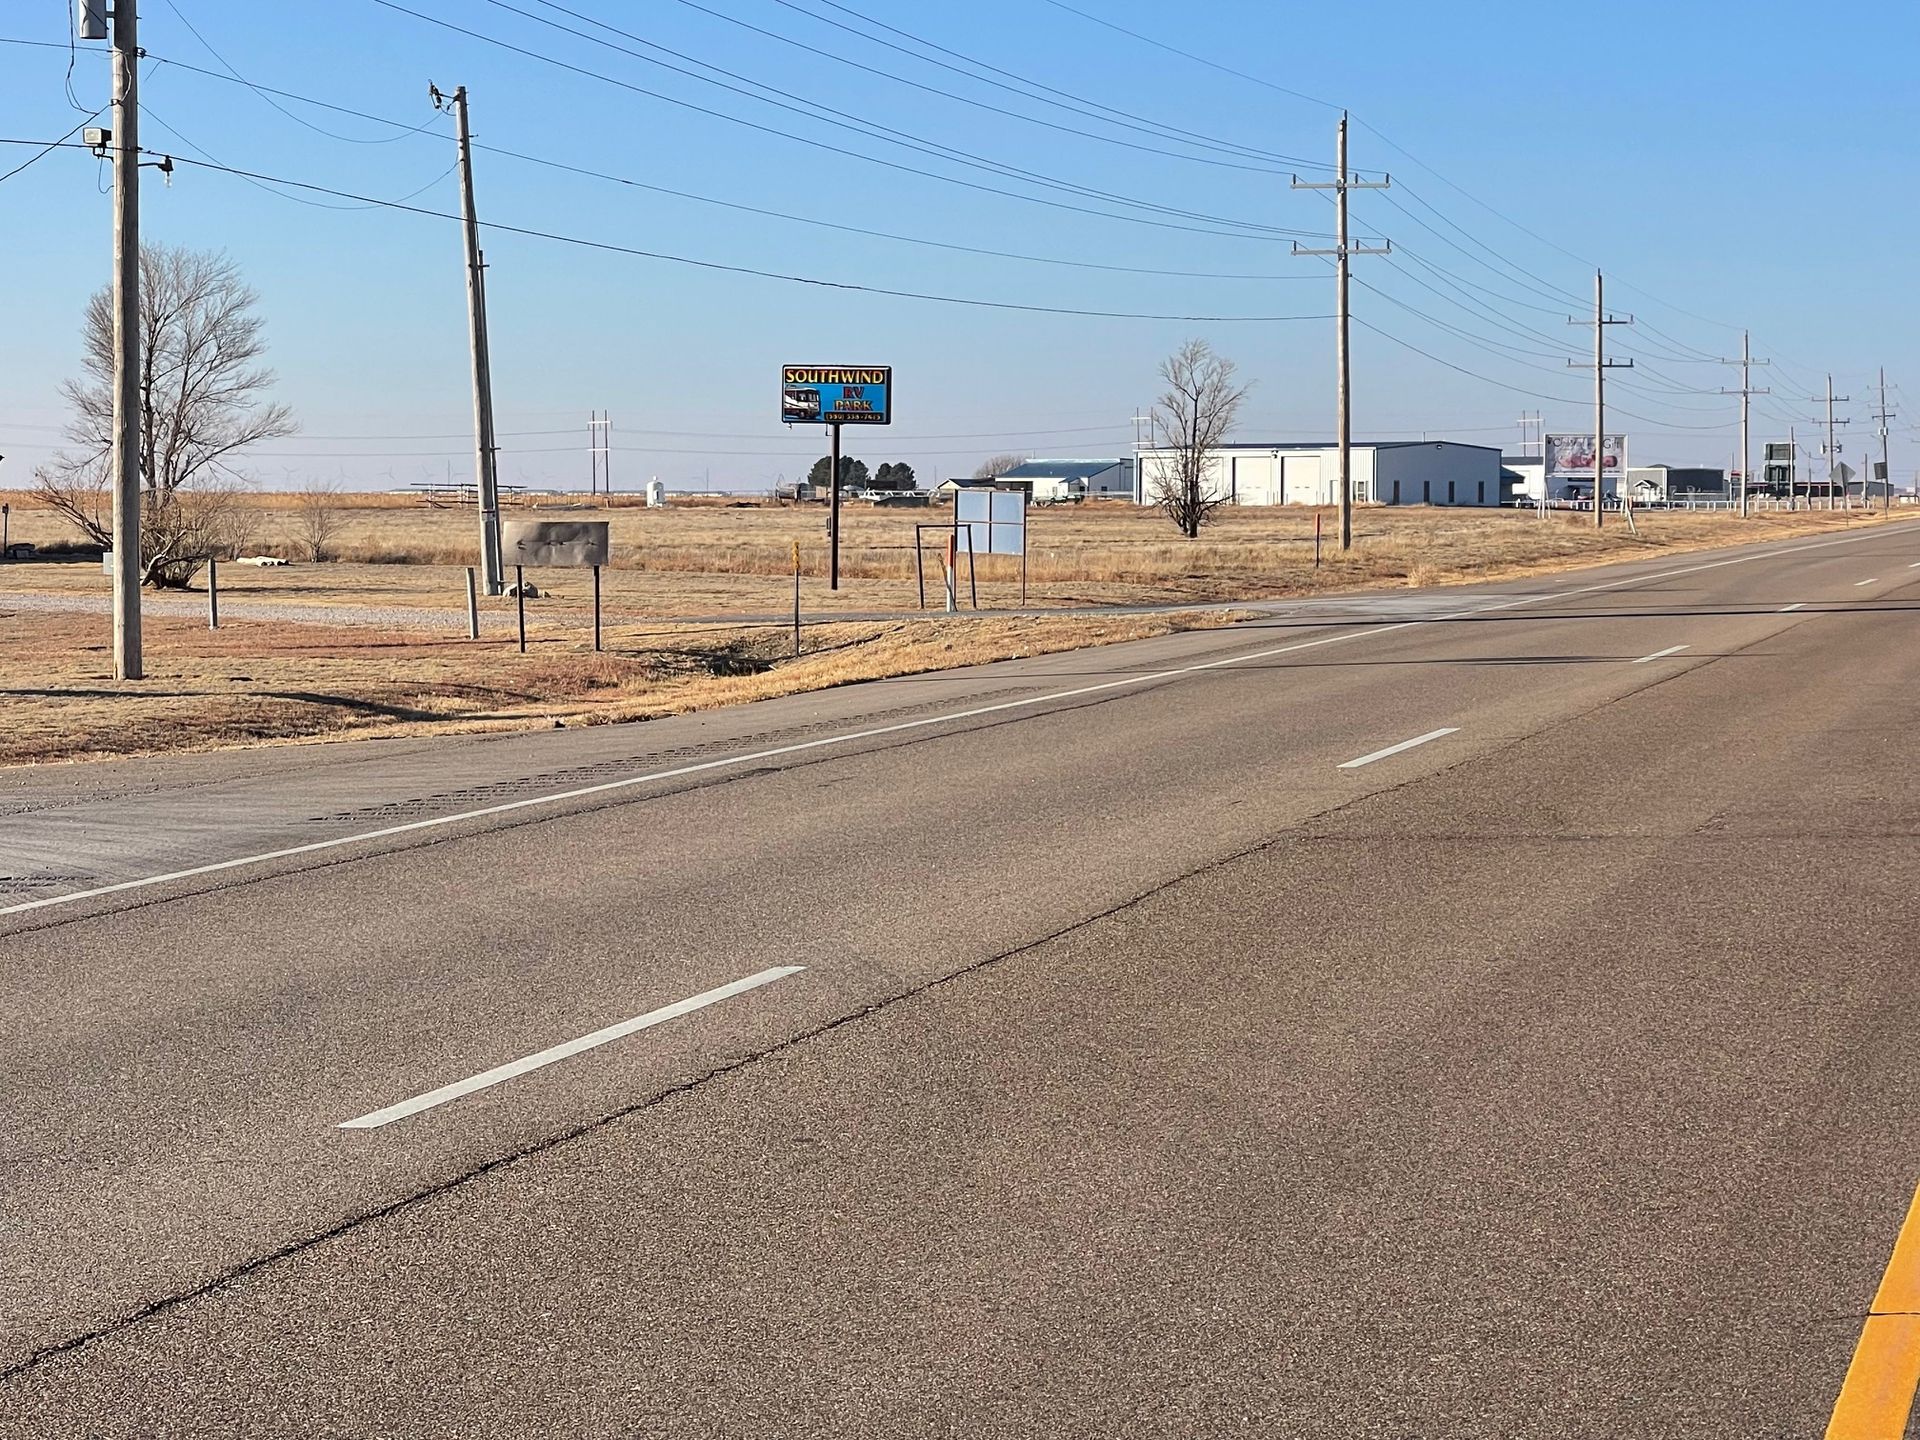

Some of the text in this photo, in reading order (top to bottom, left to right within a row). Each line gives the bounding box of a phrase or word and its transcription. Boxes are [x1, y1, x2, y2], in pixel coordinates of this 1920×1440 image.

[786, 370, 883, 383] SOUTHWIND
[843, 386, 864, 399] RV
[834, 400, 872, 411] PARK
